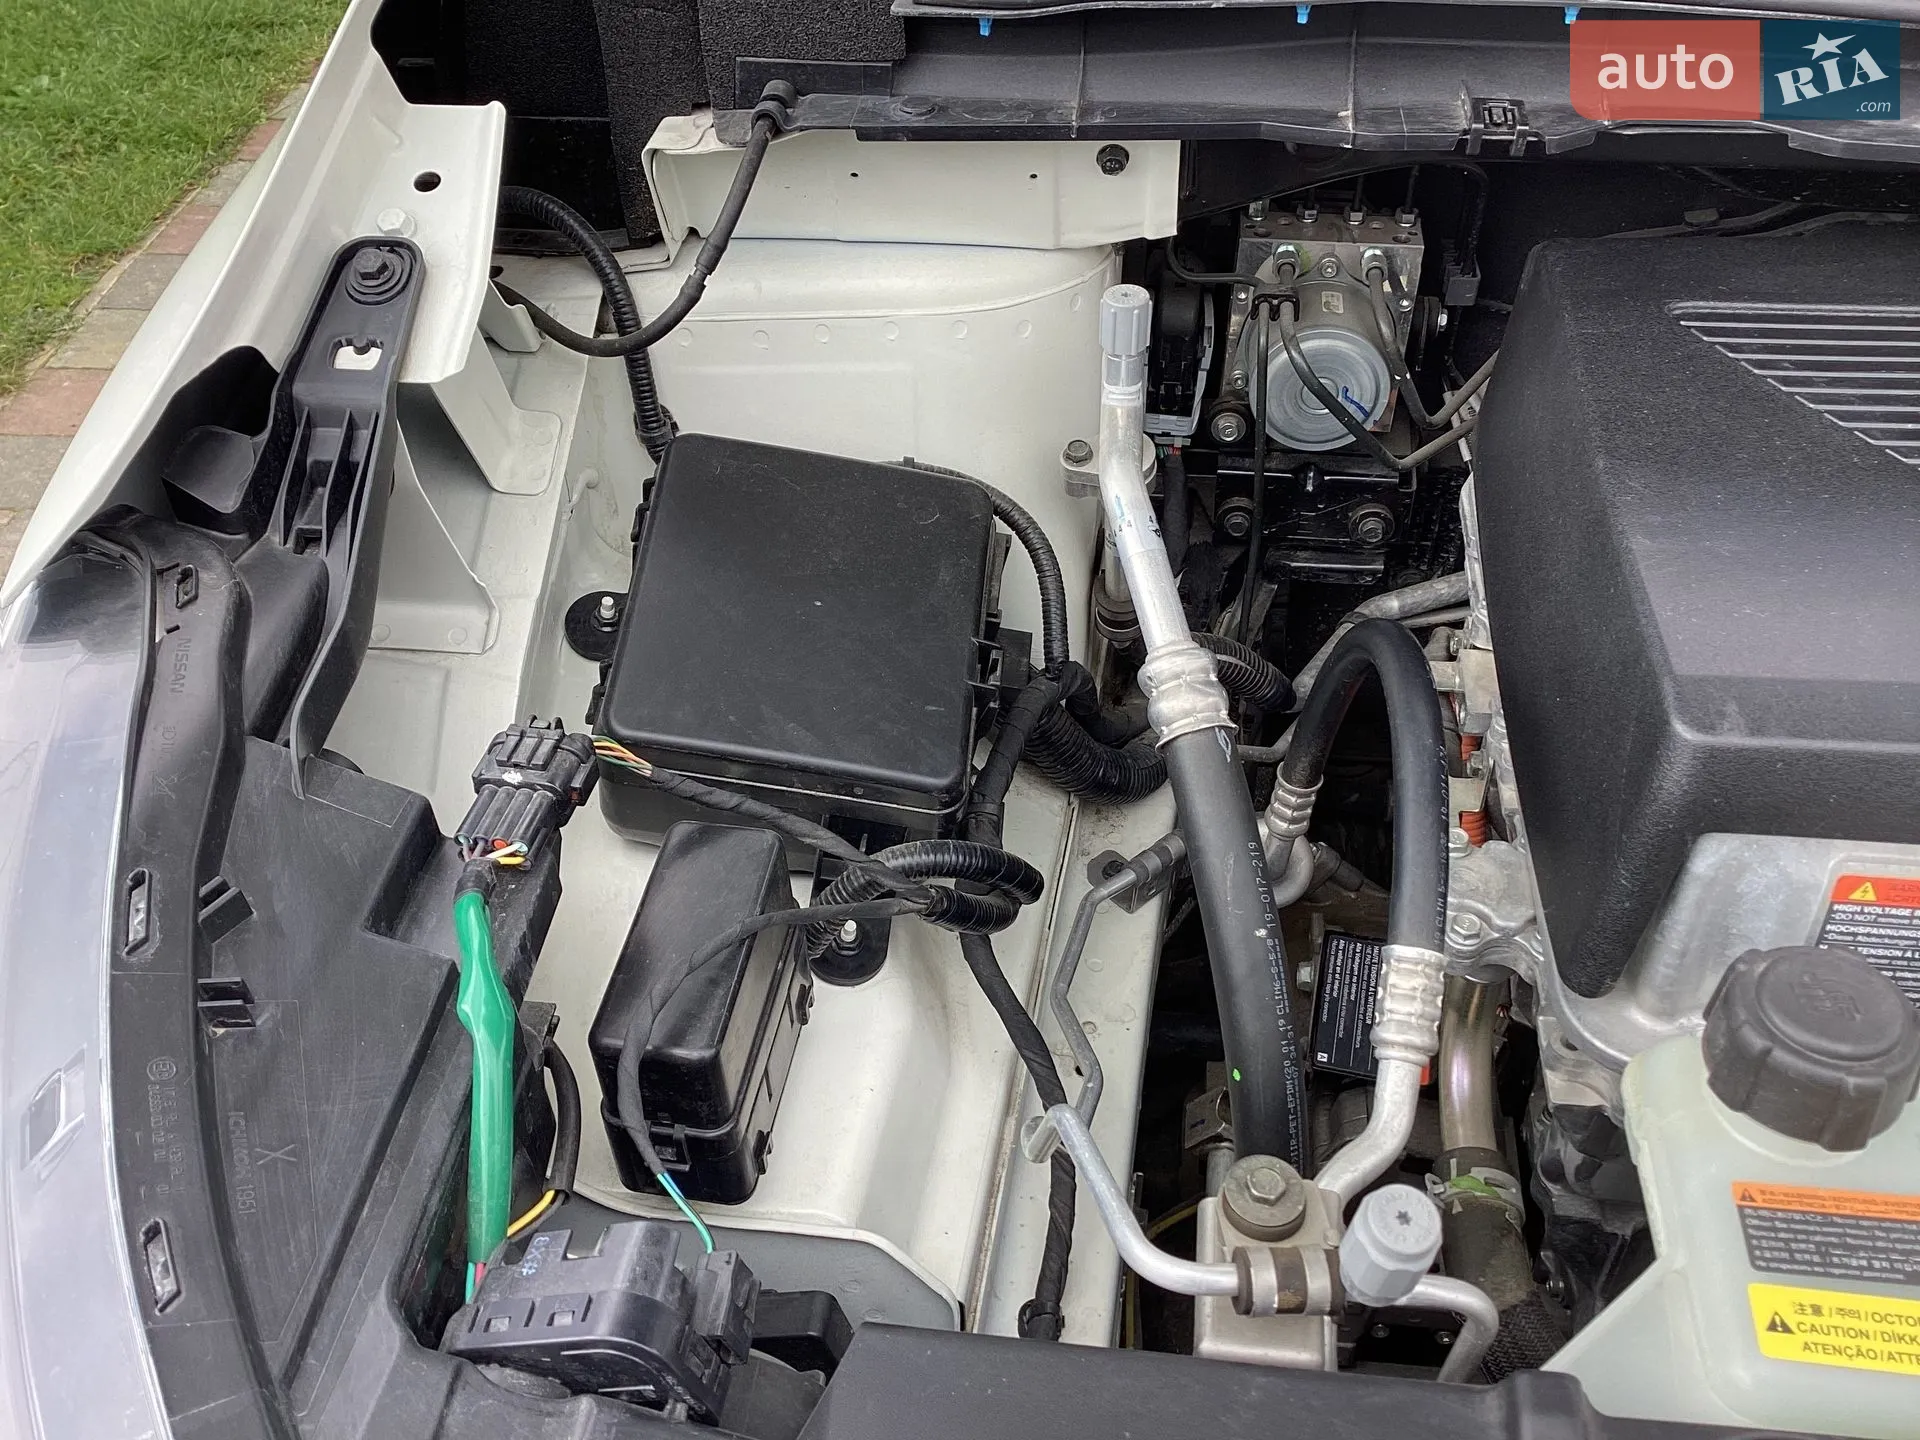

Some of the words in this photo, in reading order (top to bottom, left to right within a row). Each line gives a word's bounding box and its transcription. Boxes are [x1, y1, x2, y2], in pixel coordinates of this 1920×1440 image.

[168, 638, 191, 694] NISSAN
[1247, 841, 1276, 929] 19-017-219
[1833, 904, 1862, 914] HIGH
[1863, 905, 1912, 916] VOLTAGE
[1352, 953, 1361, 975] Voltagem
[1372, 946, 1380, 963] HAUTE
[1792, 1301, 1825, 1317] 注意
[1796, 1321, 1871, 1341] CAUTION
[1802, 1340, 1878, 1361] ATENÇÃO
